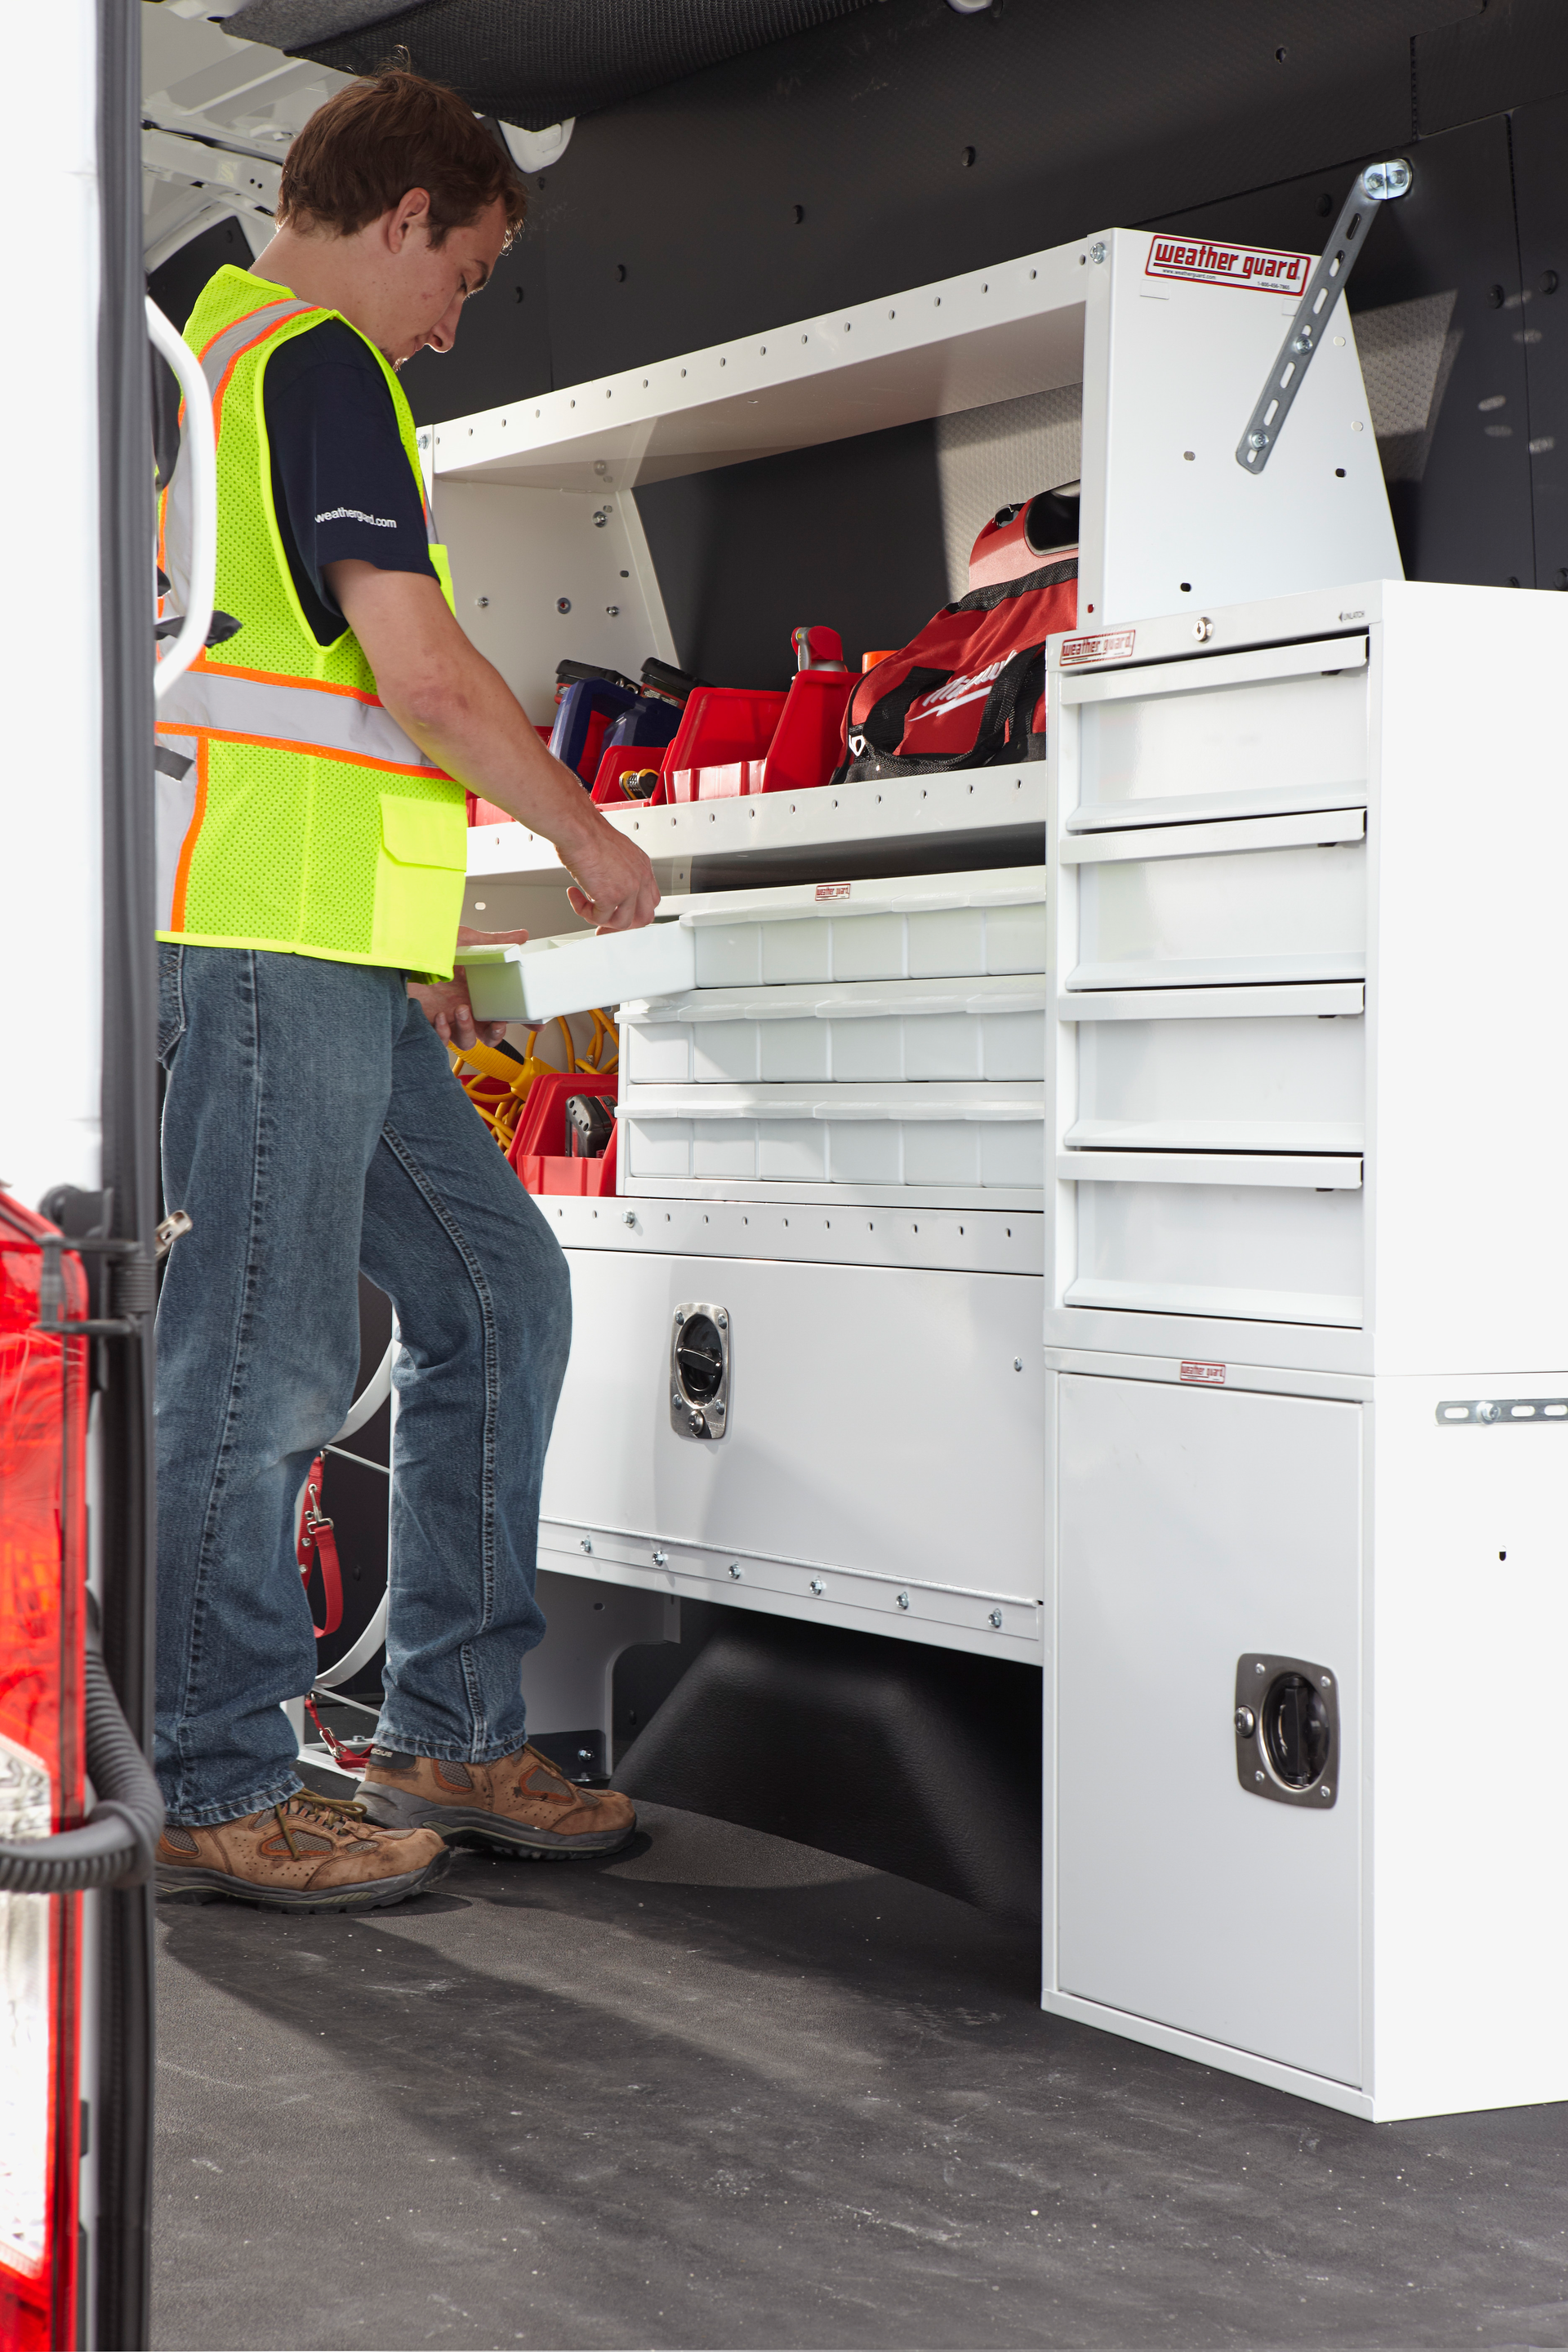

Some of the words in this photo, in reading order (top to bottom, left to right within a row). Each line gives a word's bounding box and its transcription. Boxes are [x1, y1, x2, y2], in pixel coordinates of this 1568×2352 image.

[1155, 243, 1240, 271] weather
[1242, 256, 1302, 281] guard
[1062, 639, 1101, 657] weather
[1103, 632, 1132, 654] guard
